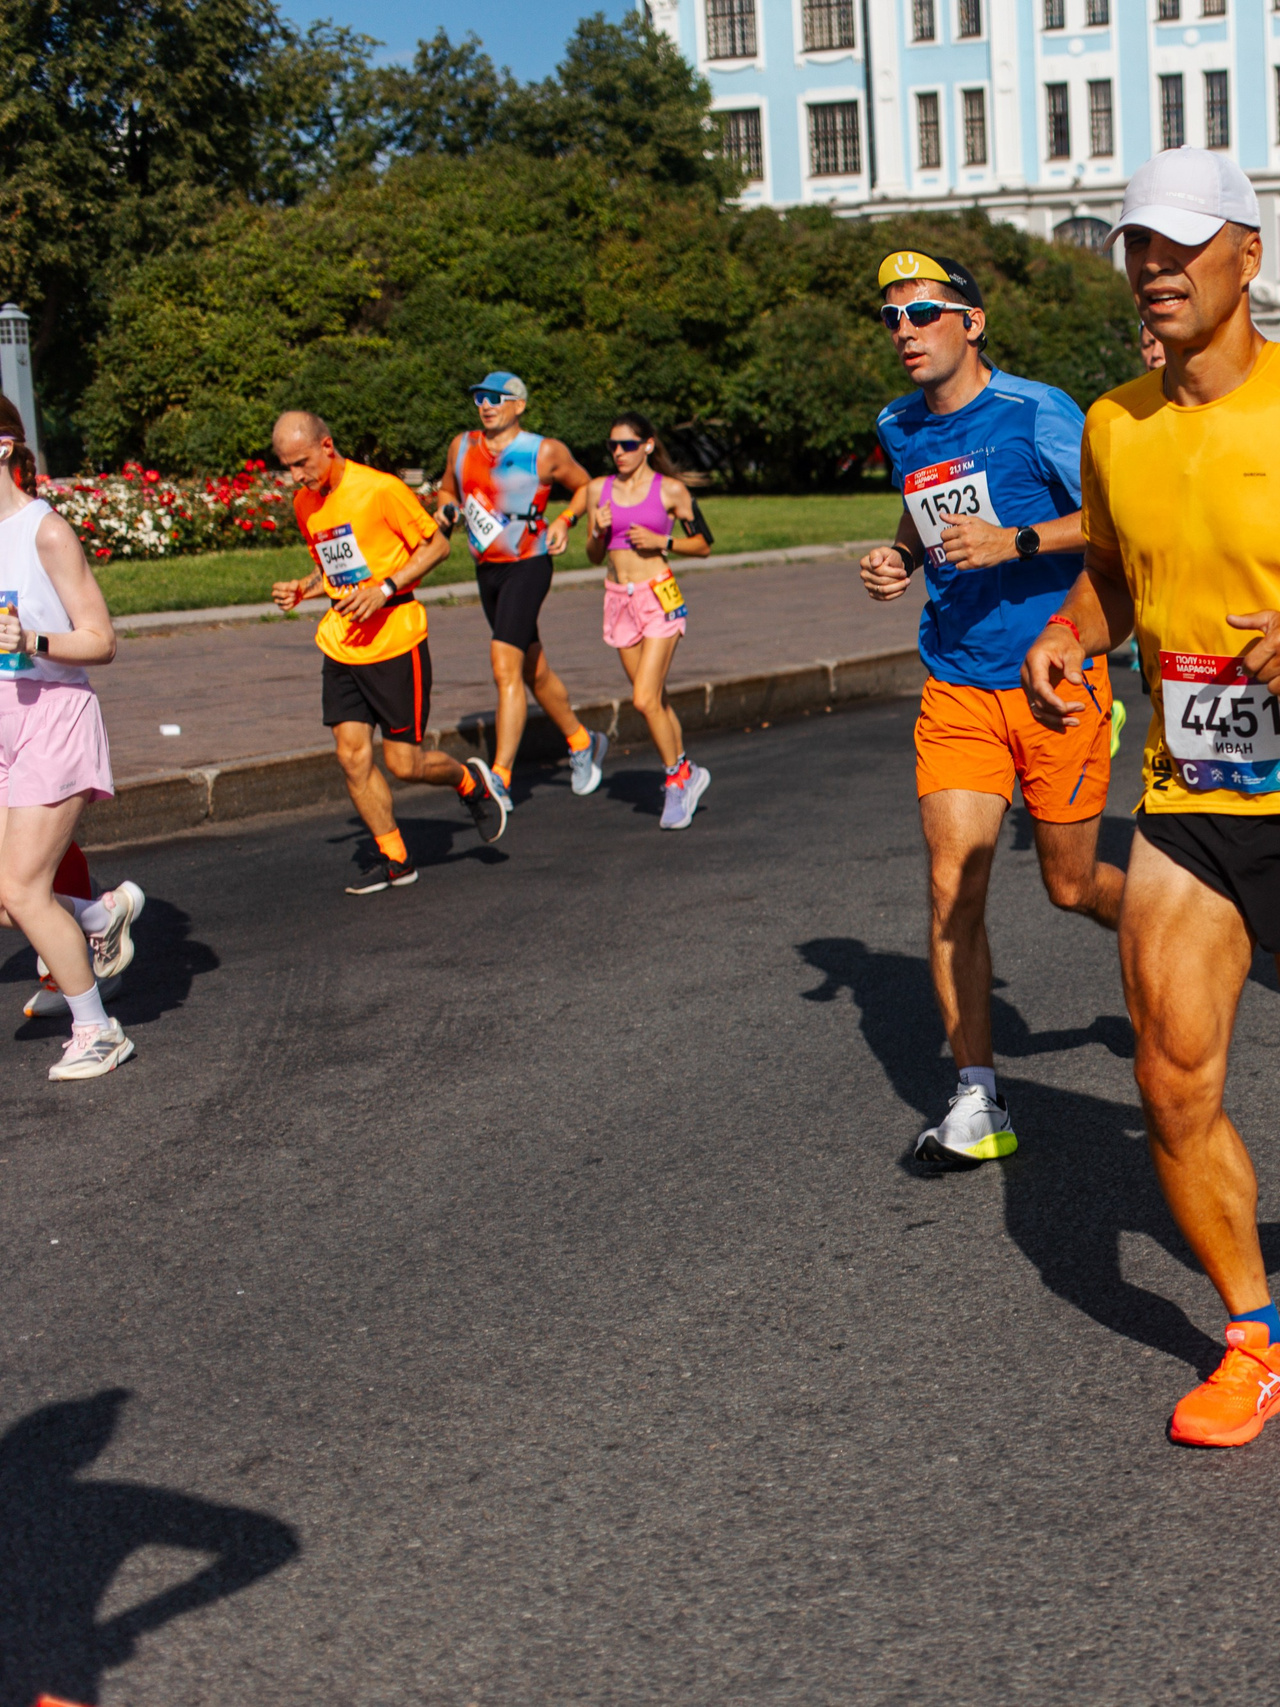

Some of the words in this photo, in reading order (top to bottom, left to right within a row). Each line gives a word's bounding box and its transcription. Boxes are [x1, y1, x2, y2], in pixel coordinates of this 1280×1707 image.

[950, 464, 961, 475] 21,1
[920, 484, 980, 527] 1523
[467, 502, 494, 536] 5148
[321, 541, 353, 565] 5448
[1175, 655, 1198, 665] ПОЛУ
[1176, 664, 1217, 675] МАРАФОН
[1215, 742, 1254, 755] ИВАН
